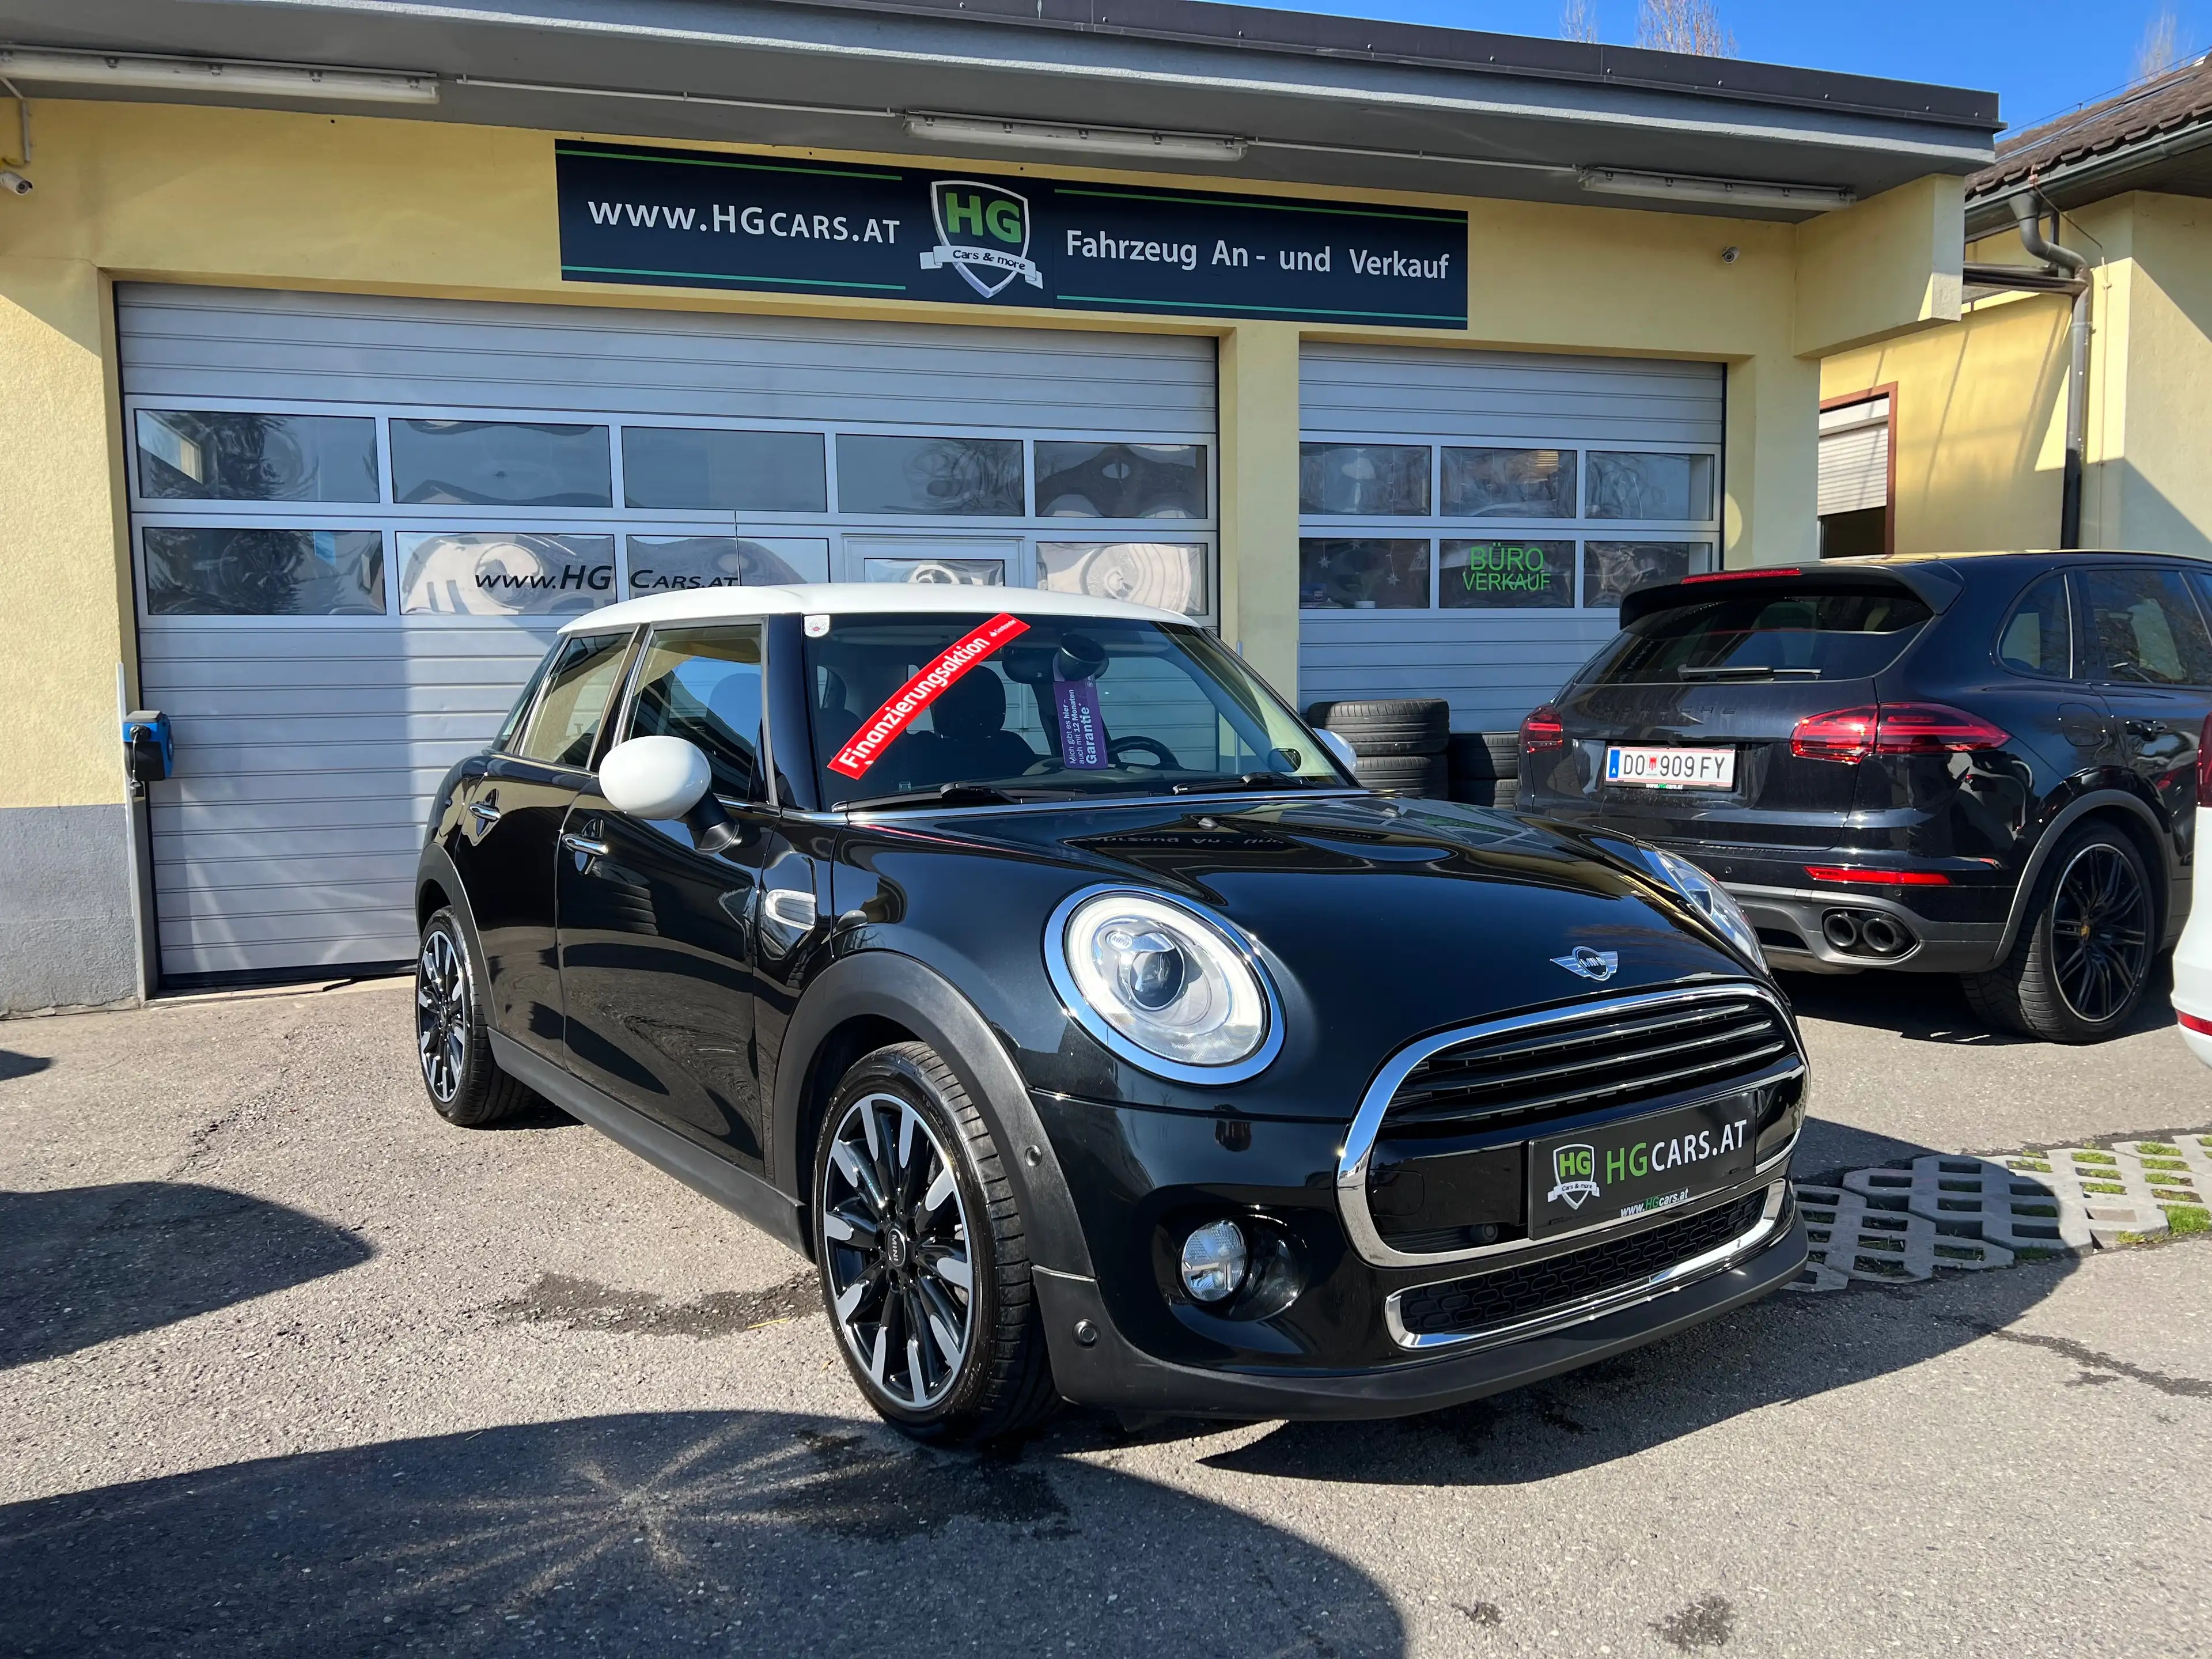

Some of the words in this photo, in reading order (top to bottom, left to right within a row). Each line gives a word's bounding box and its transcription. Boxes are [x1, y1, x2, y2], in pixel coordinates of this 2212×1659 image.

[945, 192, 1022, 243] HG
[953, 250, 979, 260] Cars
[983, 252, 995, 262] &
[997, 257, 1025, 270] more
[1066, 229, 1197, 271] Fahrzeug
[1280, 246, 1331, 272] und
[1349, 248, 1450, 279] Verkauf
[1471, 542, 1544, 571] BÜRO
[1463, 572, 1551, 590] VERKAUF
[838, 638, 991, 768] Finanzierungsaktion
[1069, 689, 1079, 721] Monaten
[1066, 721, 1071, 729] es
[1066, 728, 1075, 745] gibt
[1073, 722, 1081, 732] 12
[1080, 707, 1097, 765] Garantie
[1074, 734, 1082, 745] mit
[1069, 747, 1077, 764] Mich
[1077, 748, 1085, 765] auch
[1660, 755, 1695, 777] 909
[1700, 756, 1725, 779] FY
[1559, 1151, 1592, 1177] HG
[1607, 1119, 1747, 1184] HGCARS.AT
[1620, 1188, 1690, 1218] www.HGcars.at
